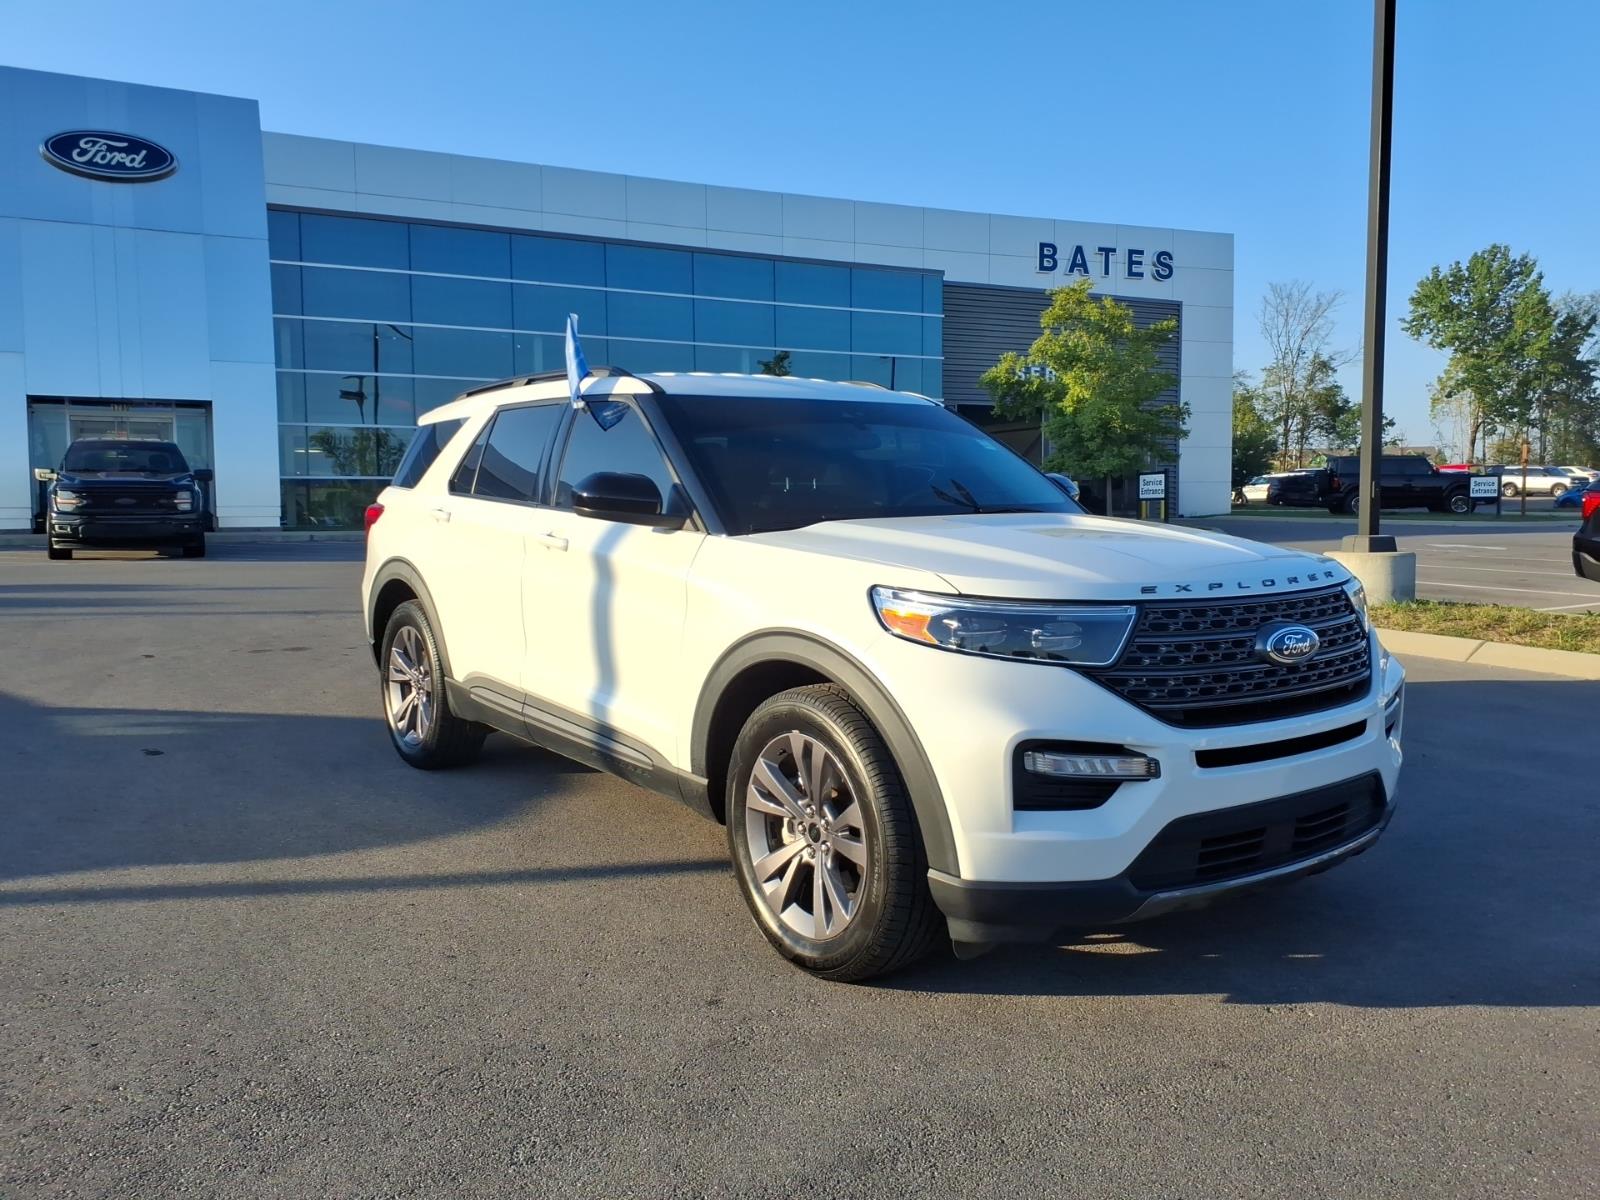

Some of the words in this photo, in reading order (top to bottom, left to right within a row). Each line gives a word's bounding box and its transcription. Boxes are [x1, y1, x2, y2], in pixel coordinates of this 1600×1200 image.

[72, 137, 147, 168] Ford
[1037, 241, 1174, 281] BATES
[1142, 479, 1162, 487] Service
[1140, 570, 1335, 595] EXPLORER
[1283, 635, 1311, 655] Ford
